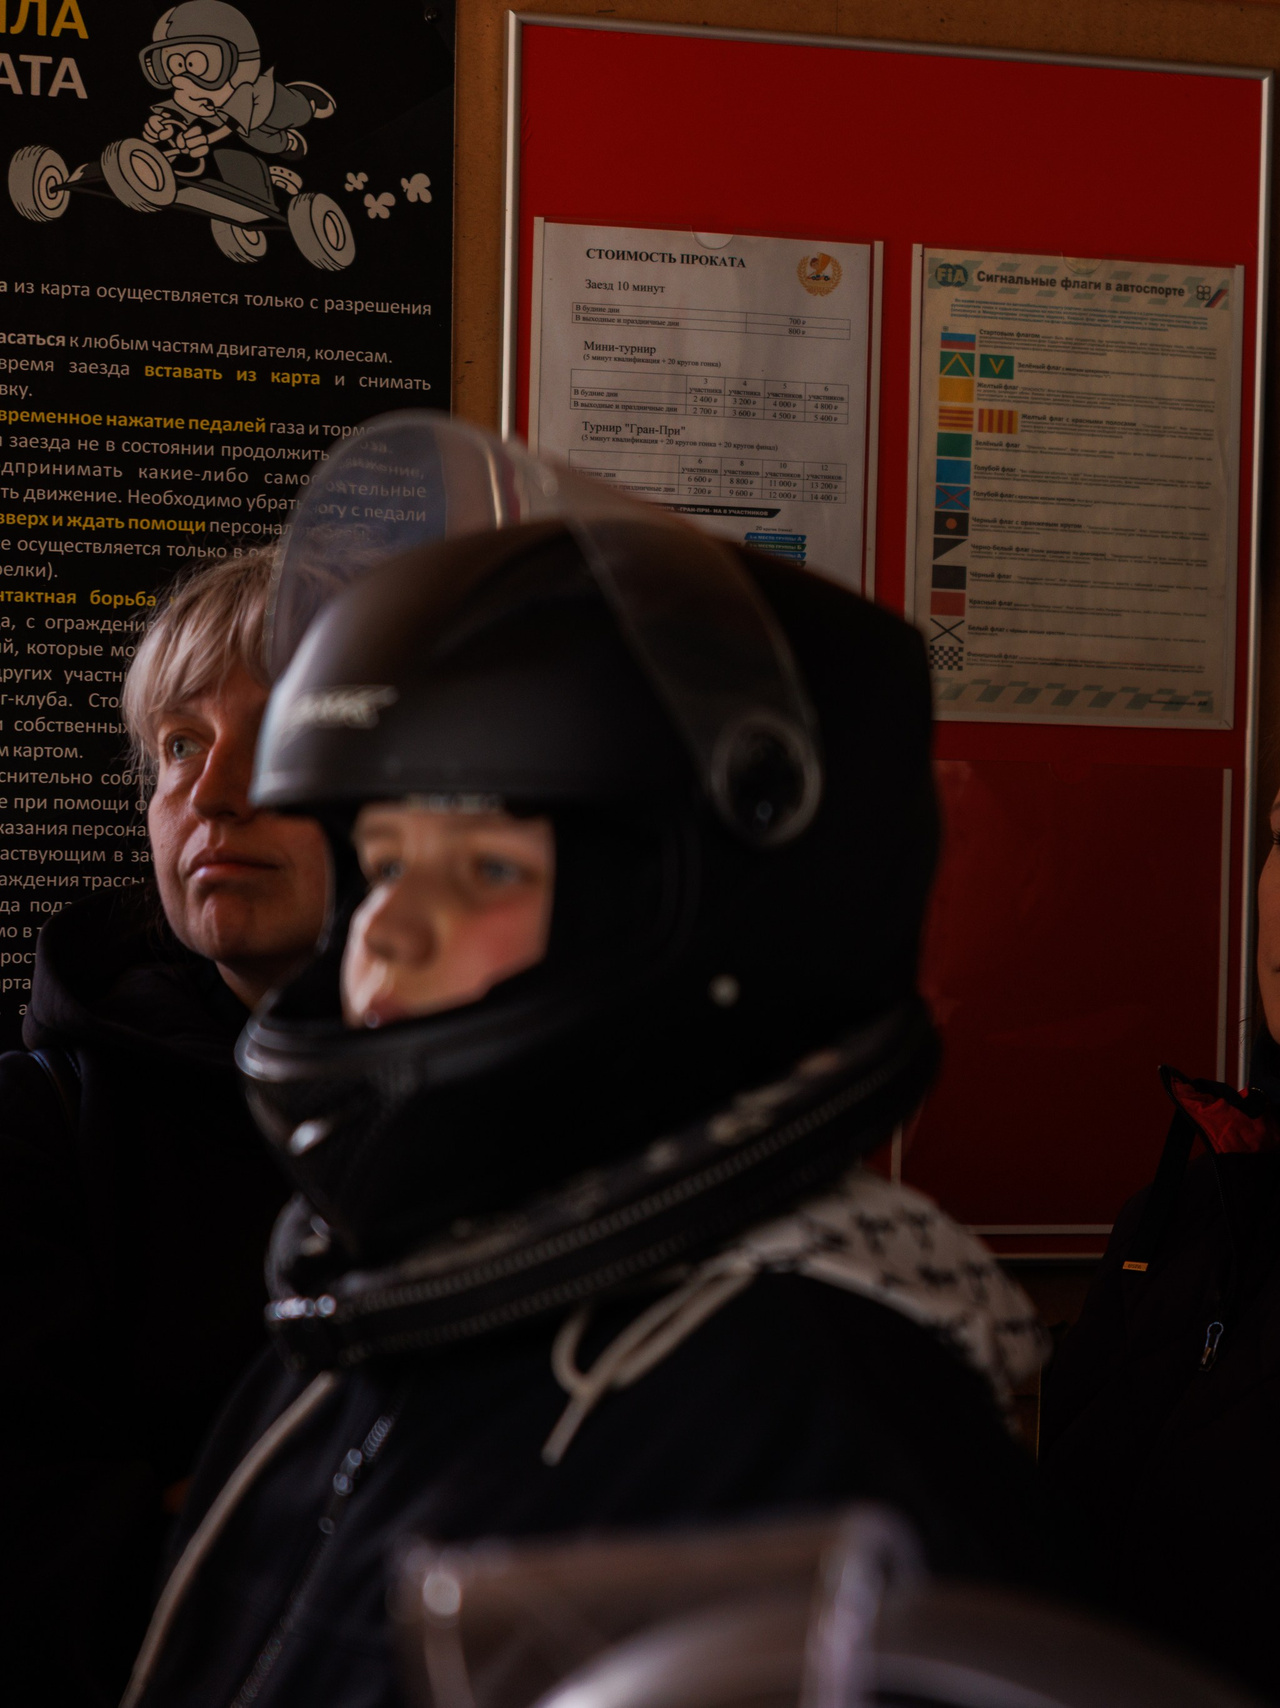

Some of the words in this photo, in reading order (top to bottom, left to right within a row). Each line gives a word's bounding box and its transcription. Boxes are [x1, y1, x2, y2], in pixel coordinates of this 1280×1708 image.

[586, 248, 677, 265] СТОИМОСТЬ
[680, 253, 746, 268] ПРОКАТА
[585, 279, 614, 292] Заезд
[617, 281, 630, 291] 10
[632, 284, 666, 295] минут
[976, 270, 1057, 288] Сигнальные
[1060, 275, 1101, 292] флаги
[1105, 282, 1112, 291] в
[1115, 282, 1185, 298] автоспорте
[14, 281, 35, 294] из
[41, 283, 91, 299] карта
[96, 285, 239, 306] осуществляется
[244, 293, 304, 309] только
[309, 298, 319, 309] с
[323, 298, 432, 316] разрешения
[788, 318, 801, 326] 700
[788, 328, 801, 336] 800
[69, 336, 79, 348] к
[81, 334, 149, 351] любым
[151, 339, 214, 355] частям
[216, 341, 311, 362] двигателя,
[314, 347, 393, 364] колесам.
[583, 340, 657, 356] Мини-турнир
[591, 356, 612, 364] минут
[613, 357, 660, 366] квалификация
[676, 360, 699, 368] кругов
[68, 361, 130, 379] заезда
[144, 364, 223, 381] вставать
[236, 369, 257, 383] из
[270, 371, 321, 388] карта
[334, 375, 345, 387] и
[358, 376, 431, 392] снимать
[106, 414, 185, 430] нажатие
[188, 416, 266, 435] педалей
[269, 422, 305, 435] газа
[308, 424, 319, 435] и
[582, 421, 622, 435] Турнир
[624, 424, 686, 436] "Гран-При"
[9, 435, 71, 453] заезда
[77, 438, 99, 451] не
[105, 440, 116, 451] в
[121, 440, 215, 456] состоянии
[220, 444, 330, 462] продолжить
[589, 436, 610, 445] минут
[612, 437, 658, 447] квалификация
[675, 440, 697, 449] кругов
[733, 443, 755, 452] кругов
[138, 464, 249, 484] какие-либо
[23, 487, 123, 504] движение.
[127, 488, 243, 510] Необходимо
[364, 507, 427, 523] педали
[52, 516, 63, 527] и
[66, 516, 125, 531] ждать
[128, 517, 206, 535] помощи
[17, 538, 161, 556] осуществляется
[167, 544, 227, 558] только
[233, 547, 243, 558] в
[90, 589, 156, 609] борьба
[26, 617, 35, 629] с
[27, 643, 103, 659] которые
[0, 668, 52, 684] ругих
[13, 745, 84, 761] картом.
[14, 798, 48, 812] при
[53, 798, 129, 814] помощи
[72, 824, 149, 839] персона
[114, 851, 124, 862] в
